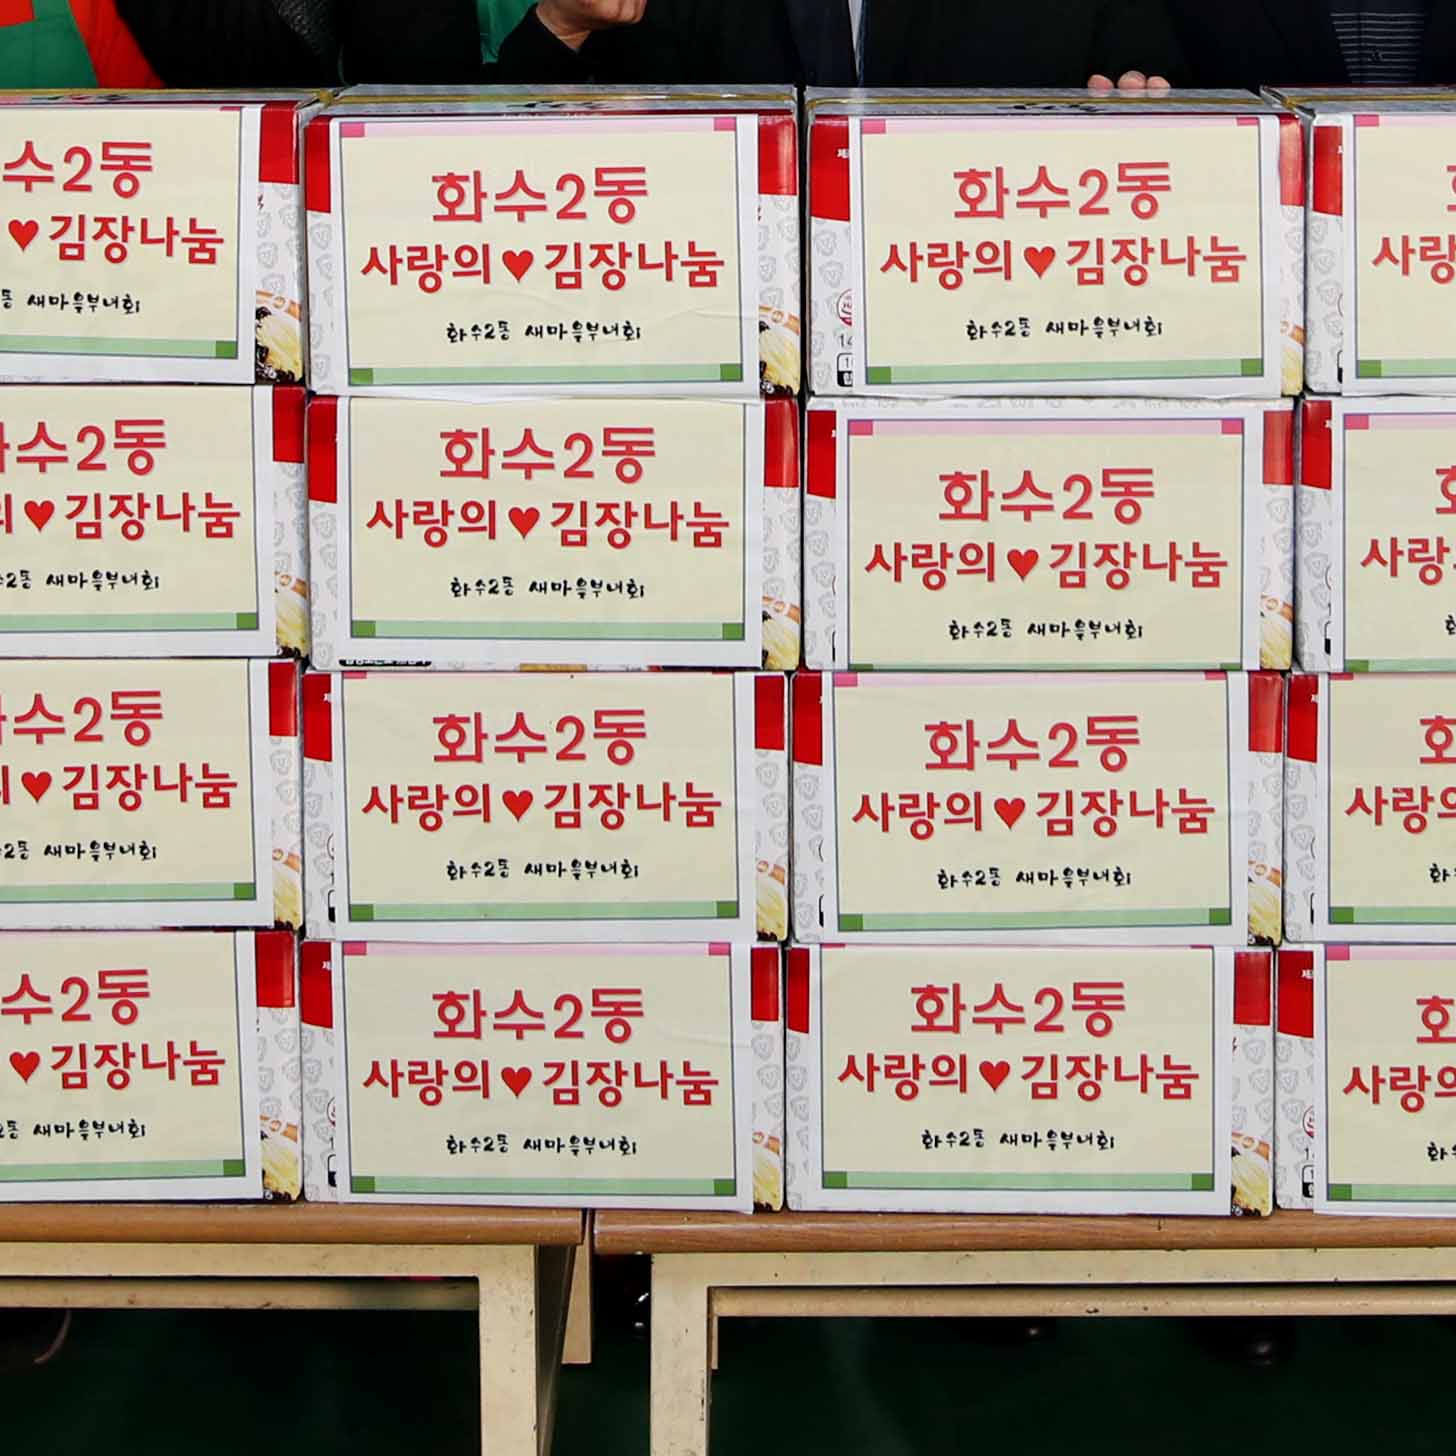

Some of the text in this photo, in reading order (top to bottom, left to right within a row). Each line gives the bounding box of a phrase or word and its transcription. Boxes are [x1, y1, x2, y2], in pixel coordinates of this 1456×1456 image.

[430, 164, 651, 226] 화수2동
[952, 160, 1172, 221] 화수2동
[445, 319, 511, 345] 화수2동
[439, 425, 658, 486] 화수2동
[937, 466, 1155, 526] 화수2동
[430, 707, 649, 768] 화수2동
[923, 714, 1143, 774] 화수2동
[431, 986, 646, 1045] 화수2동
[910, 980, 1127, 1040] 화수2동
[920, 1126, 986, 1151] 화수2동
